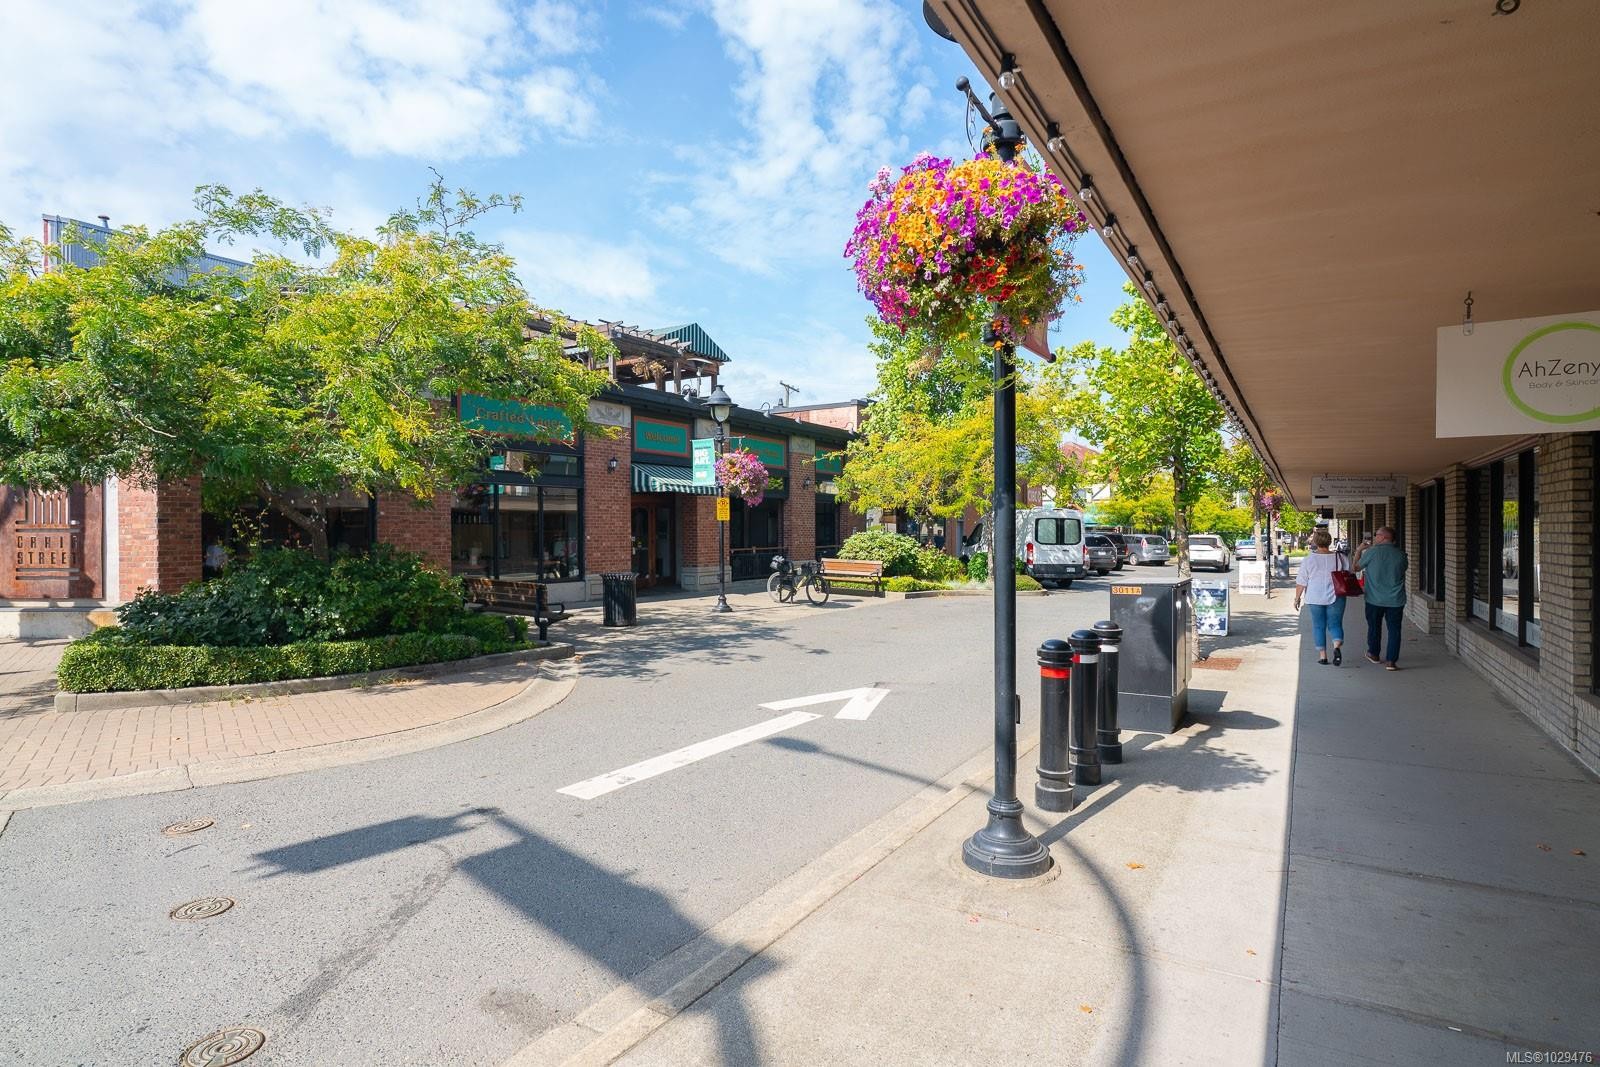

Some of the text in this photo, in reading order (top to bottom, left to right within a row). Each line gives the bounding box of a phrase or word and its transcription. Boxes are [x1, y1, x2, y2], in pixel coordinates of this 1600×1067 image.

[1528, 381, 1552, 390] Body
[476, 407, 525, 424] Crafted
[17, 536, 77, 548] CRAIG
[17, 552, 77, 564] STREET
[1112, 586, 1141, 594] 3011A
